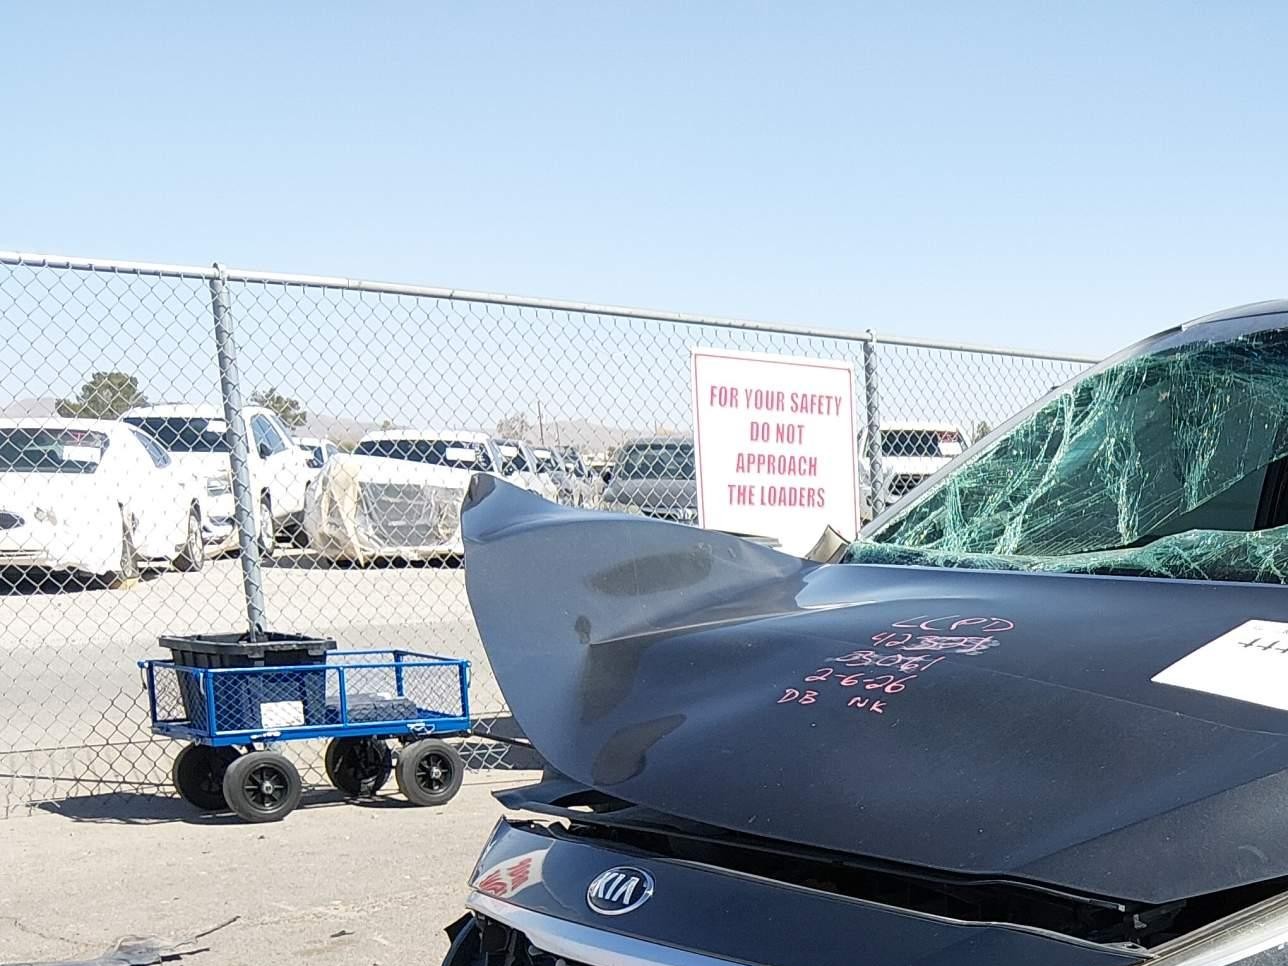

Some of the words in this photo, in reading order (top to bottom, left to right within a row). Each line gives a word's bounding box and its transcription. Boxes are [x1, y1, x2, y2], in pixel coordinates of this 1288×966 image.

[709, 385, 739, 408] FOR
[744, 388, 785, 412] YOUR
[790, 392, 842, 416] SAFETY
[749, 421, 770, 442] DO
[775, 423, 805, 445] NOT
[735, 452, 818, 477] APPROACH
[727, 484, 755, 506] THE
[759, 485, 825, 508] LOADERS
[805, 668, 917, 693] 2-6-26
[592, 871, 640, 905] KIA
